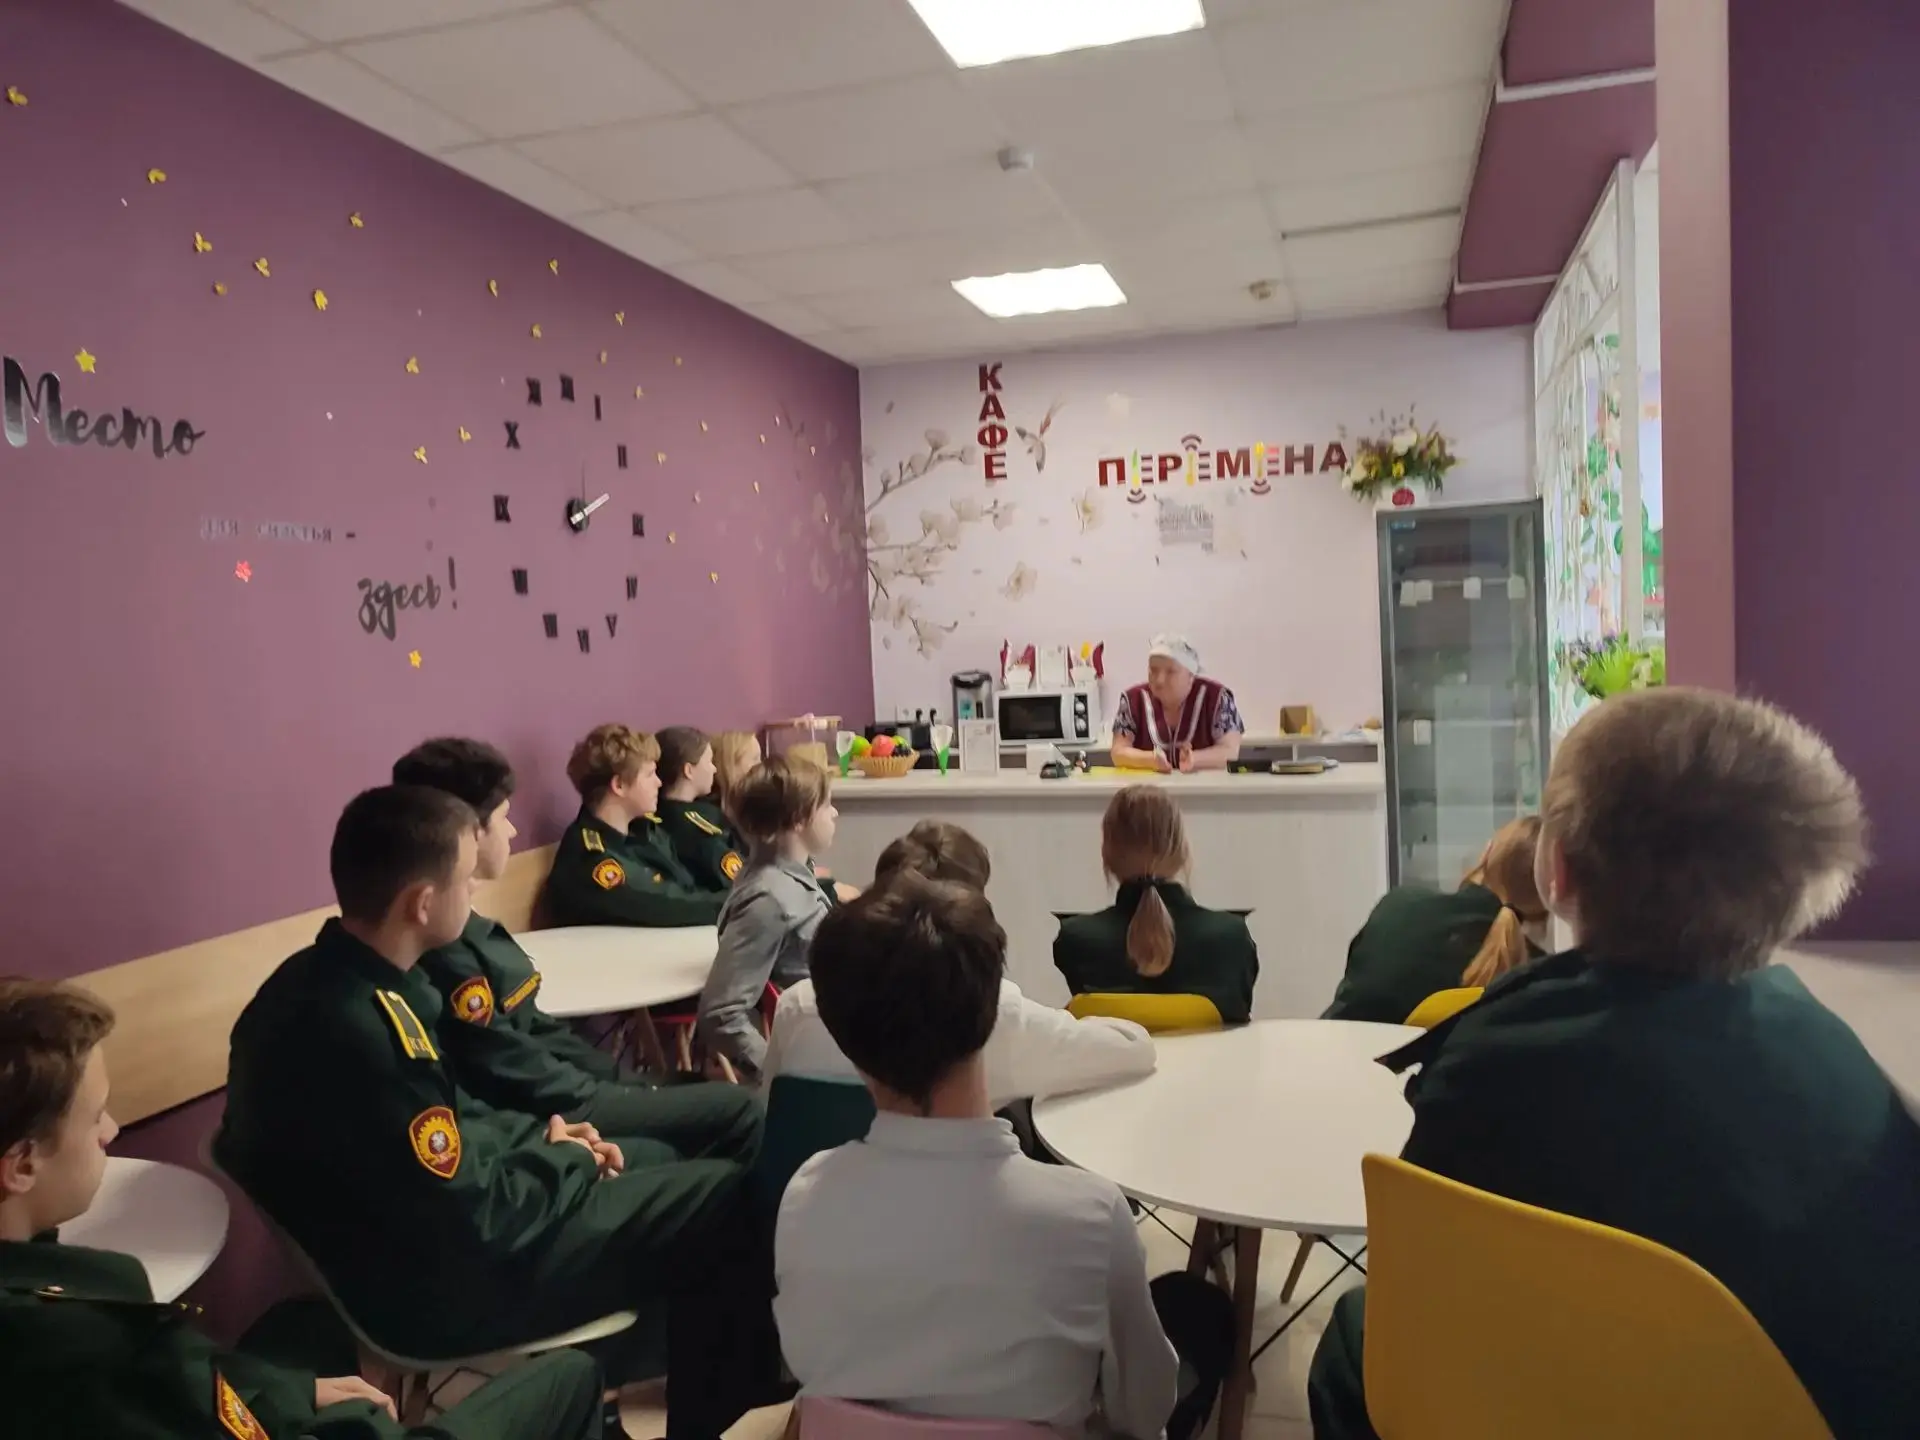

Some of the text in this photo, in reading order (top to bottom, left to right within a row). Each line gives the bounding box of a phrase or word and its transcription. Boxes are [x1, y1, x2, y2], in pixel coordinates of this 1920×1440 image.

[3, 355, 206, 459] Место
[977, 361, 1008, 480] КАФЕ
[1098, 441, 1348, 487] ПЕРЕМЕНА
